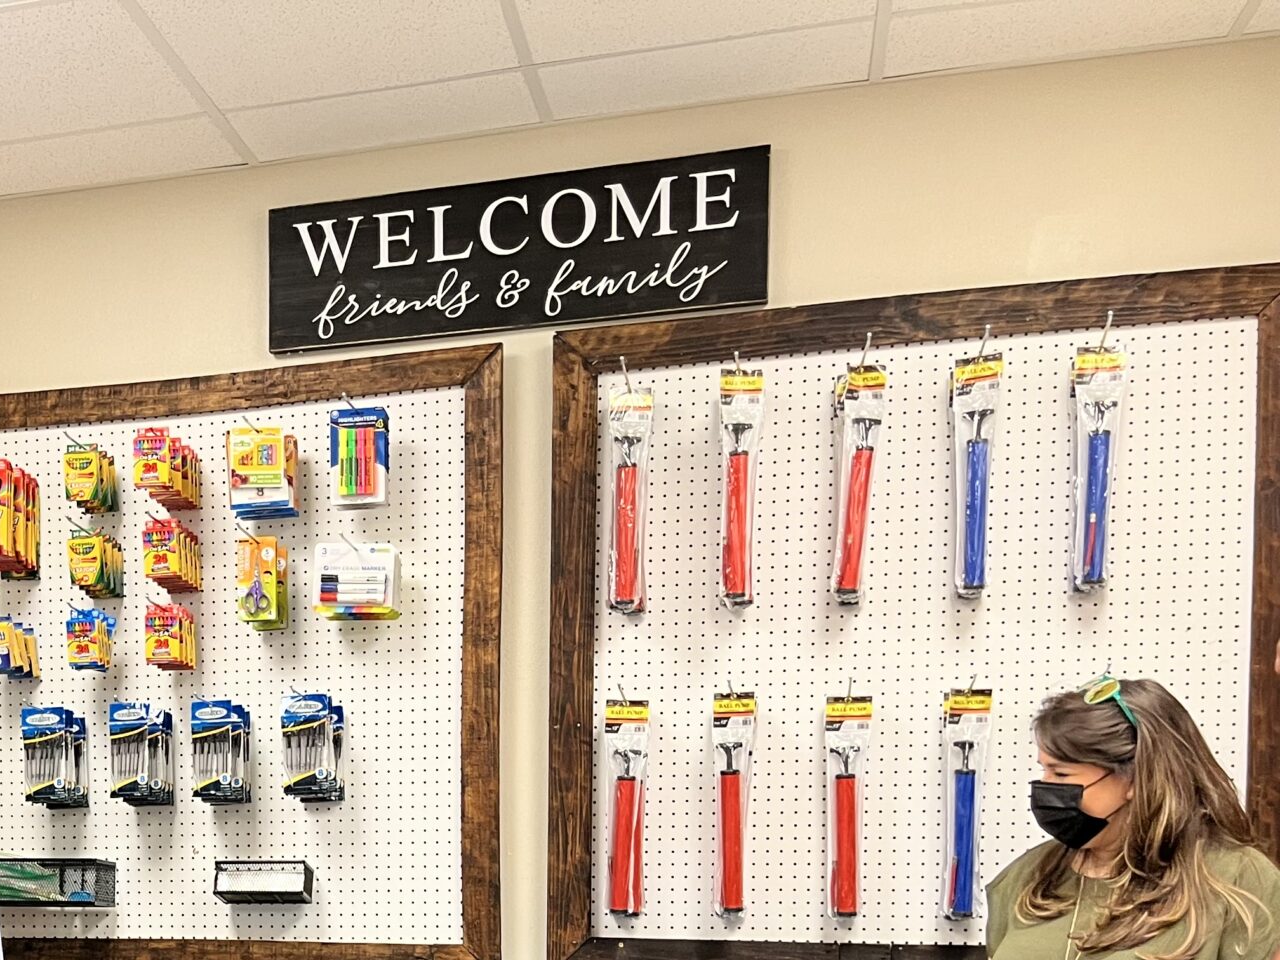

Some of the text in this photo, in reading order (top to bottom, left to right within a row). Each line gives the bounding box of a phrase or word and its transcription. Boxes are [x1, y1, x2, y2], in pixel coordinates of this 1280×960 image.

[293, 168, 741, 276] WELCOME
[313, 241, 728, 340] friends & family
[142, 463, 159, 475] 24
[153, 554, 168, 564] 24
[154, 639, 169, 649] 24
